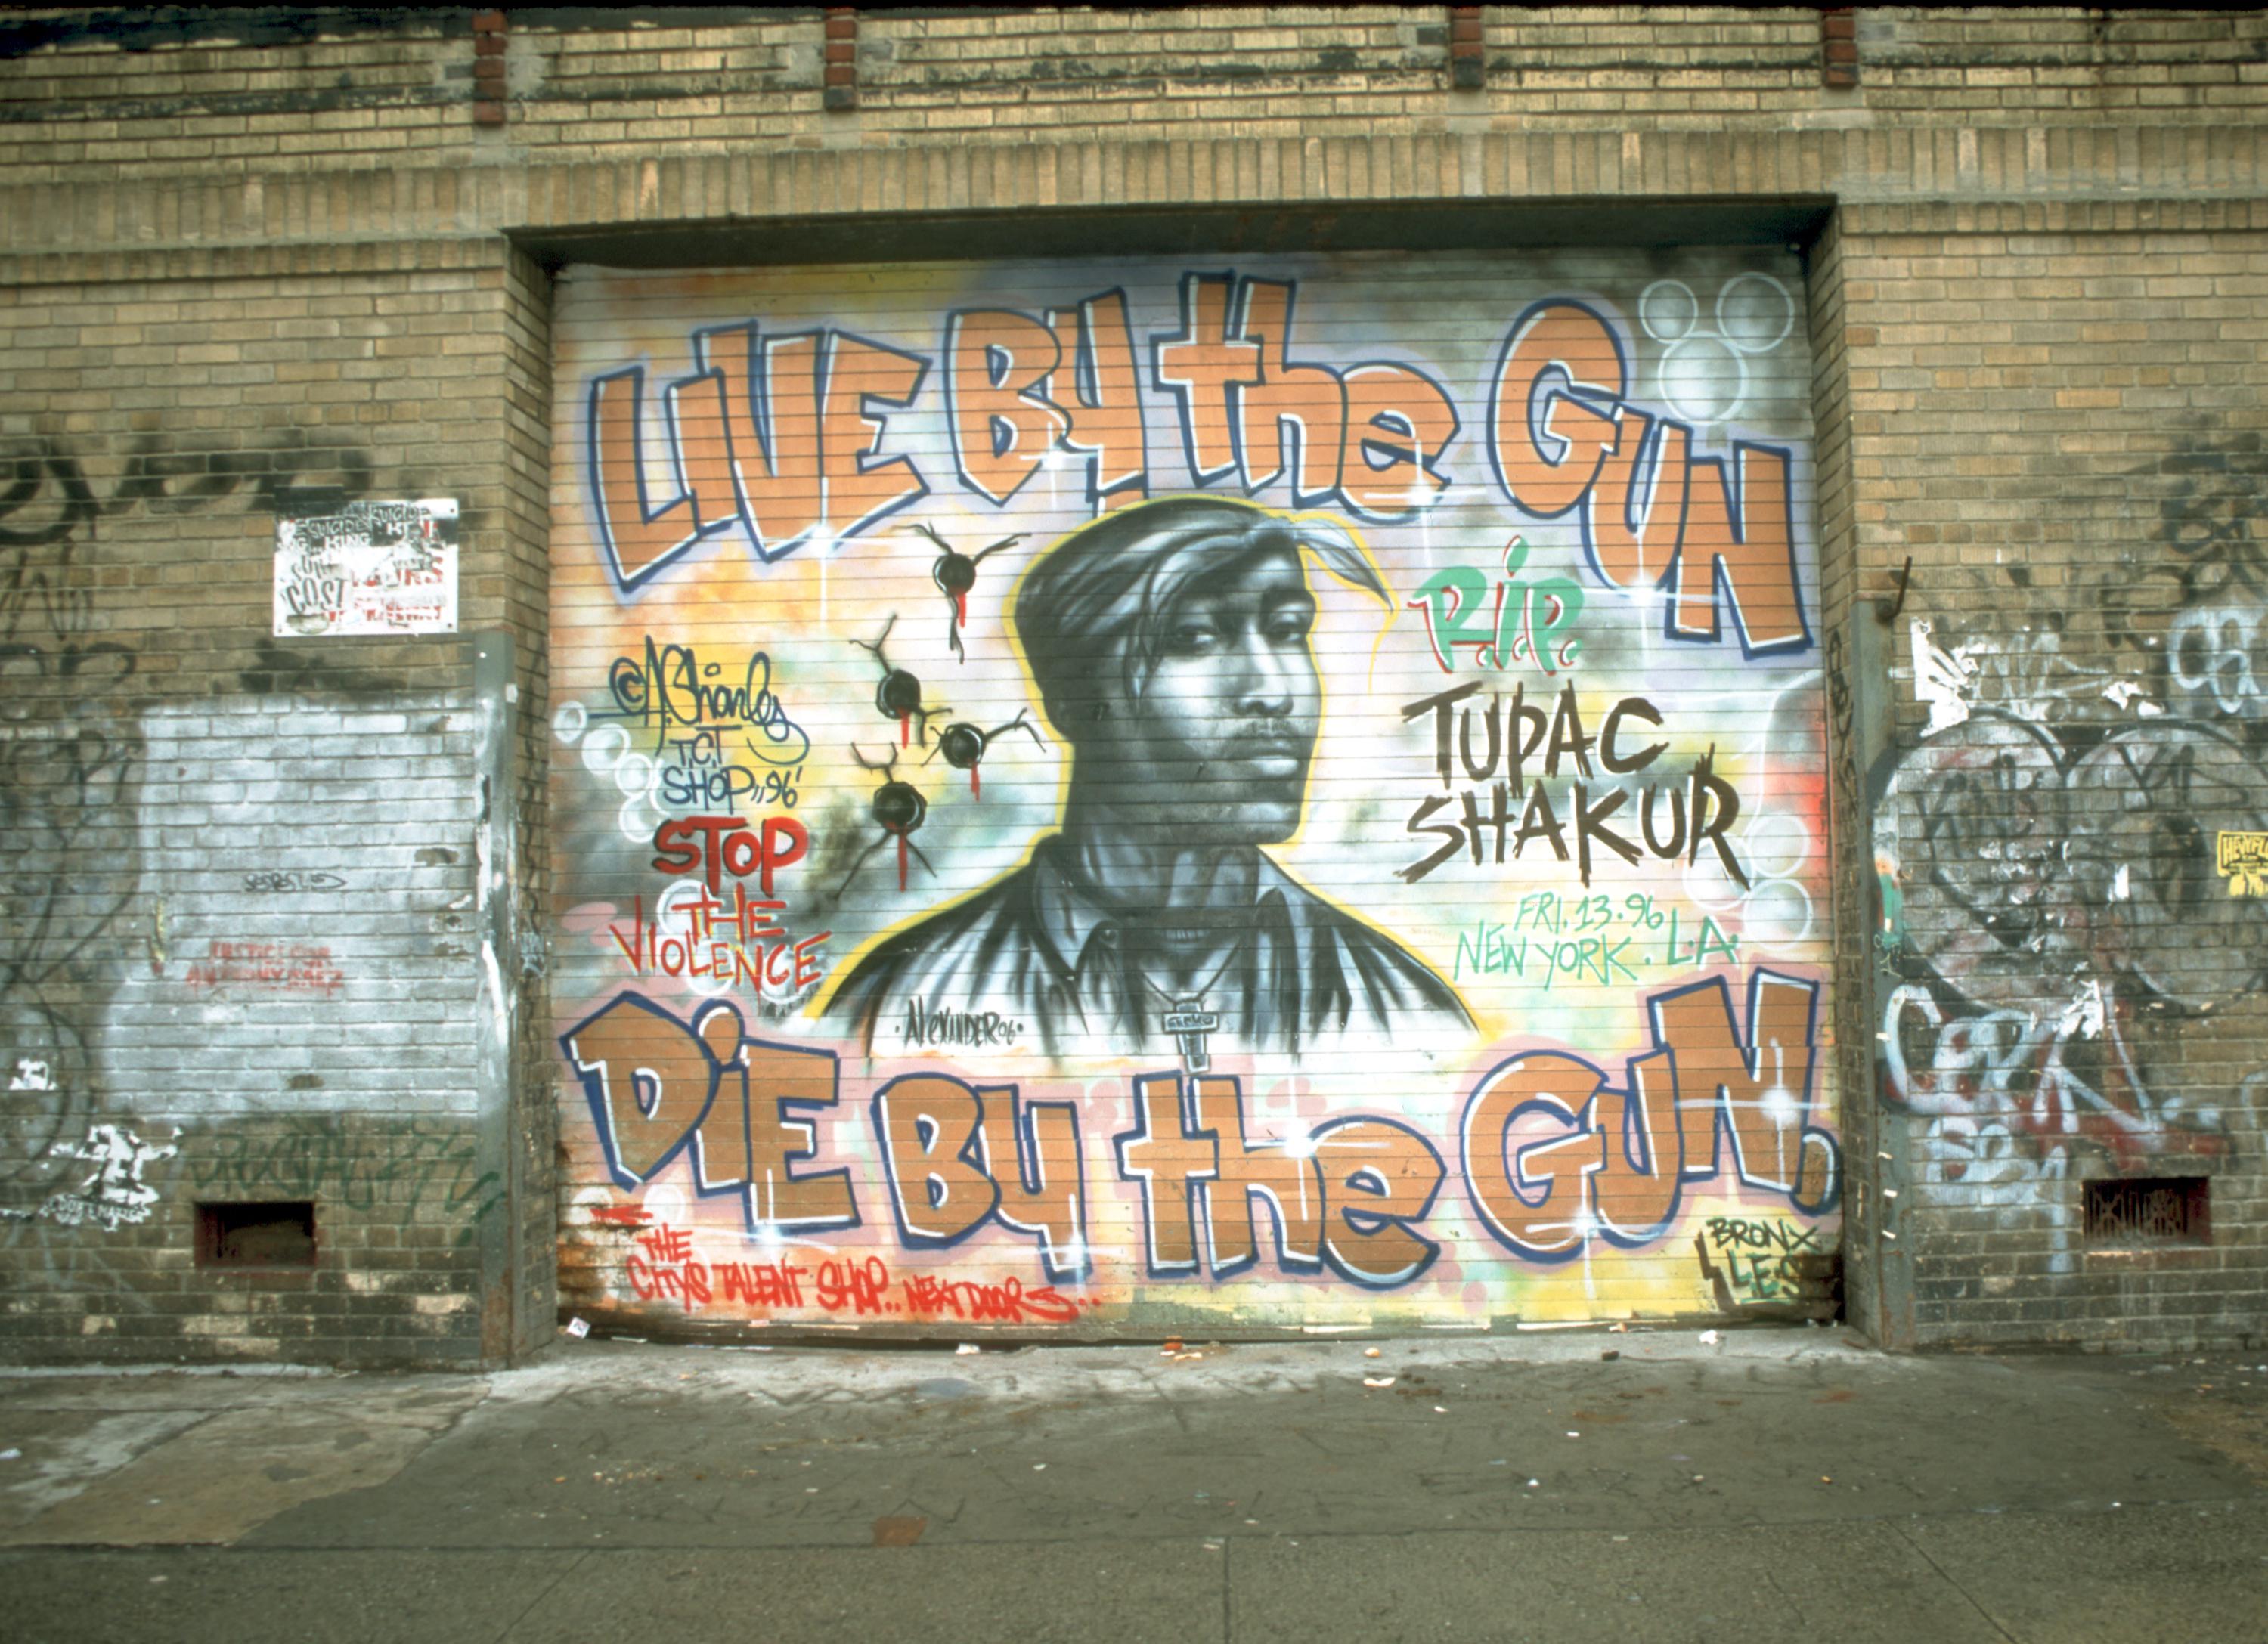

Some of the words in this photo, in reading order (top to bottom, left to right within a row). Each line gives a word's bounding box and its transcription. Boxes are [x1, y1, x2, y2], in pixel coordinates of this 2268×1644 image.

[286, 577, 347, 615] COST
[1401, 678, 1670, 799] TUPAC
[1392, 742, 1752, 892] SHAKUR
[652, 815, 810, 899] STOP
[609, 895, 832, 993] VIOLENCE
[671, 883, 788, 946] THE
[1453, 920, 1529, 982] NEW
[637, 1222, 693, 1265] THE
[1706, 1216, 1820, 1255] BRONX
[711, 1258, 809, 1308] TALENT
